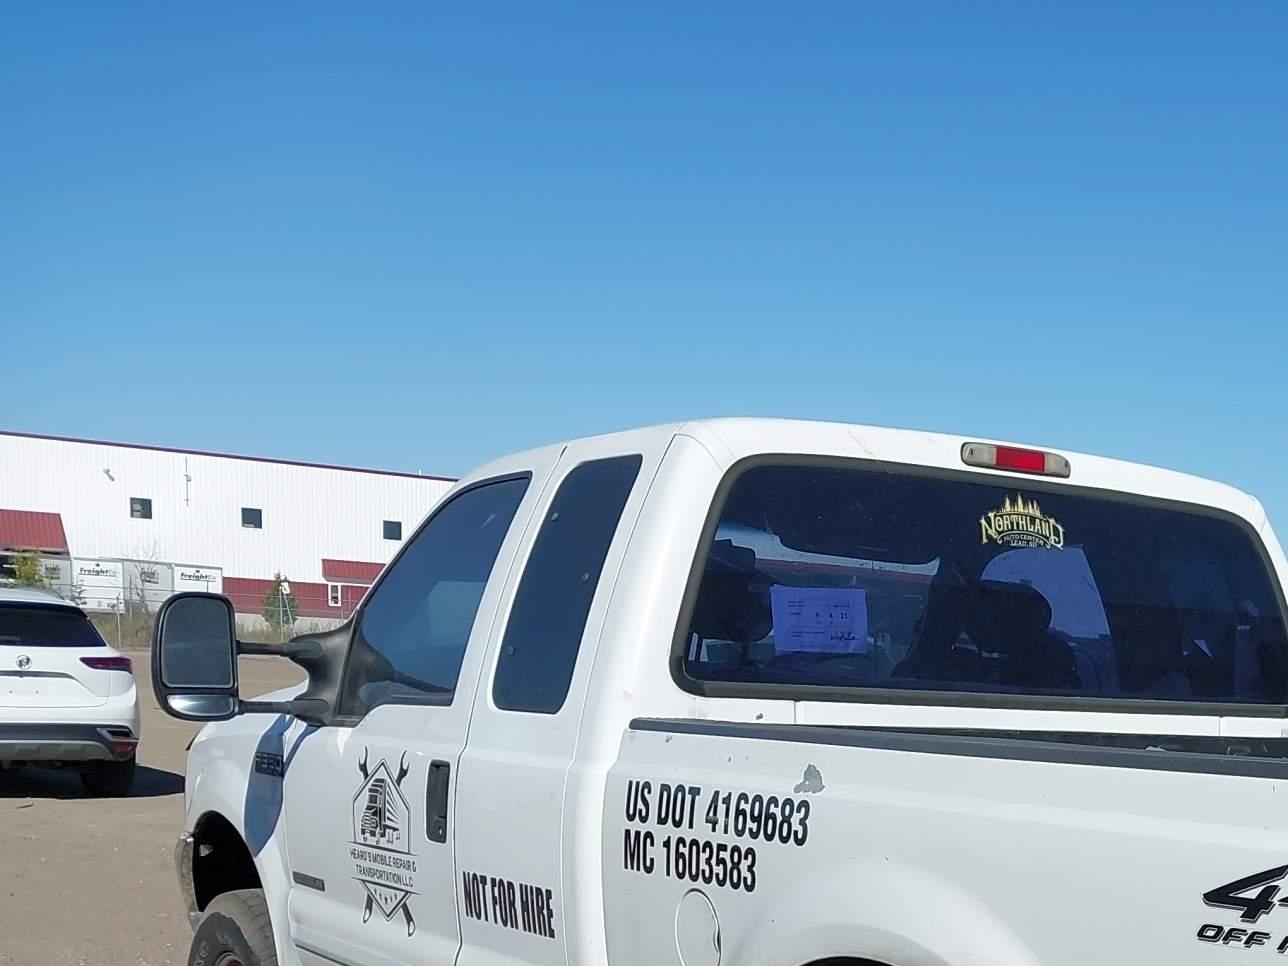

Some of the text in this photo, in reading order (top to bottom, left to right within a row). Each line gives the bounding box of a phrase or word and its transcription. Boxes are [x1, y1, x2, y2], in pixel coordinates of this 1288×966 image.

[979, 511, 1064, 549] NORTHLAND
[625, 780, 810, 846] US DOT 4169683
[356, 864, 414, 888] TRANSPORTATION LLC
[372, 852, 393, 868] MOBILE
[393, 857, 411, 872] REPAIR
[624, 829, 756, 893] MC 1603583
[462, 871, 556, 940] NOT FOR HIRE
[1196, 923, 1272, 948] OFF
